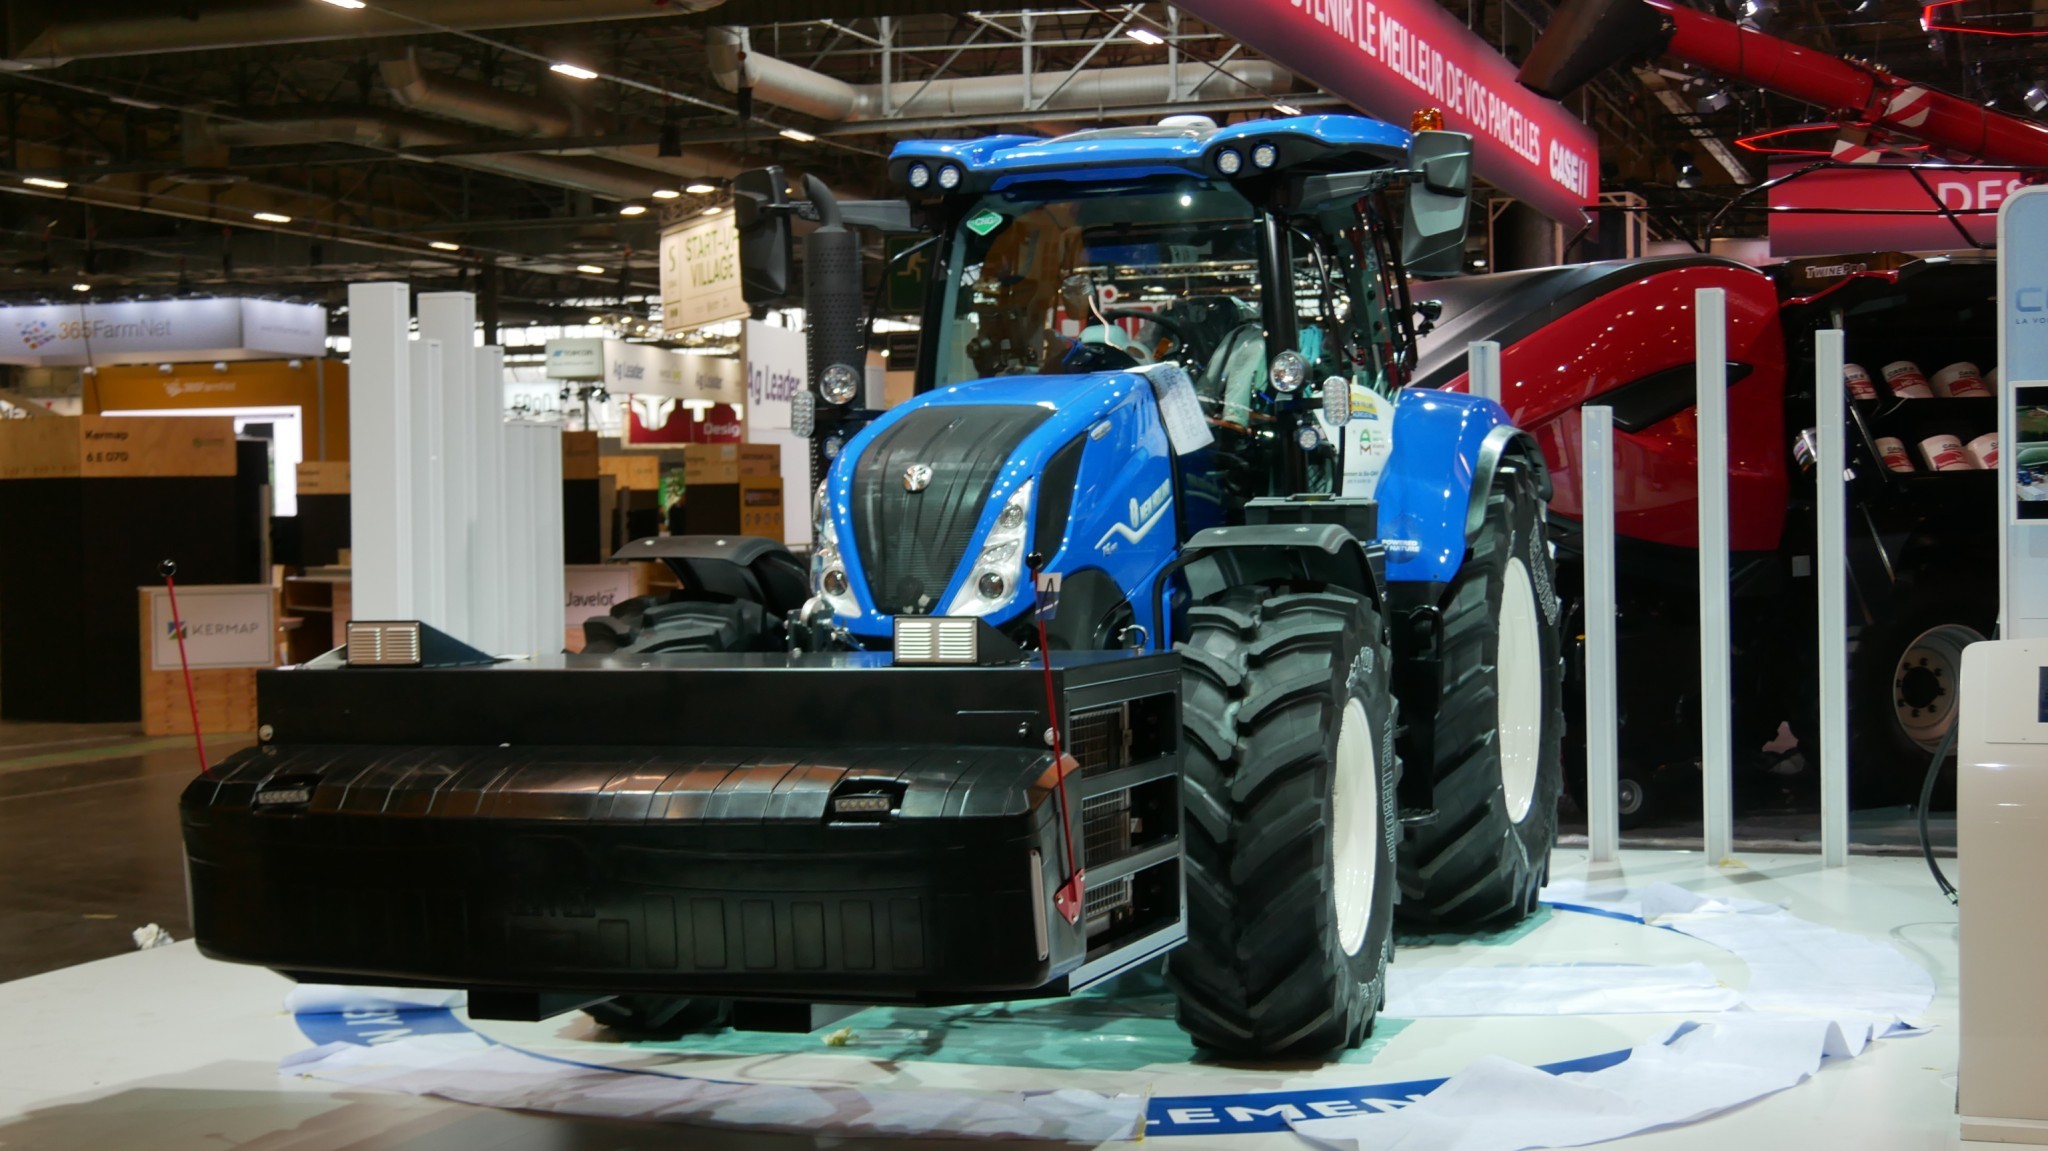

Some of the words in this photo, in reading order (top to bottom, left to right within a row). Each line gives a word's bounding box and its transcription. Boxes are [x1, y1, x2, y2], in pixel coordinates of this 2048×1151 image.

[1291, 0, 1354, 42] NIR
[1359, 0, 1376, 57] LE
[1380, 11, 1443, 102] MEILLEUR
[1447, 61, 1463, 115] DE
[1464, 73, 1486, 130] VOS
[1489, 92, 1540, 166] PARCELLES
[1550, 138, 1578, 193] CASE
[690, 253, 734, 288] VILLAGE
[58, 318, 172, 340] 365FarmNet
[748, 361, 761, 406] Ag
[765, 365, 800, 402] Leader
[85, 430, 128, 441] Kermap
[86, 452, 93, 462] 6
[565, 590, 616, 607] Javelot
[191, 622, 259, 636] KERMAP
[1382, 712, 1396, 863] TRELLEBORG
[1145, 1093, 1428, 1125] EMEN
